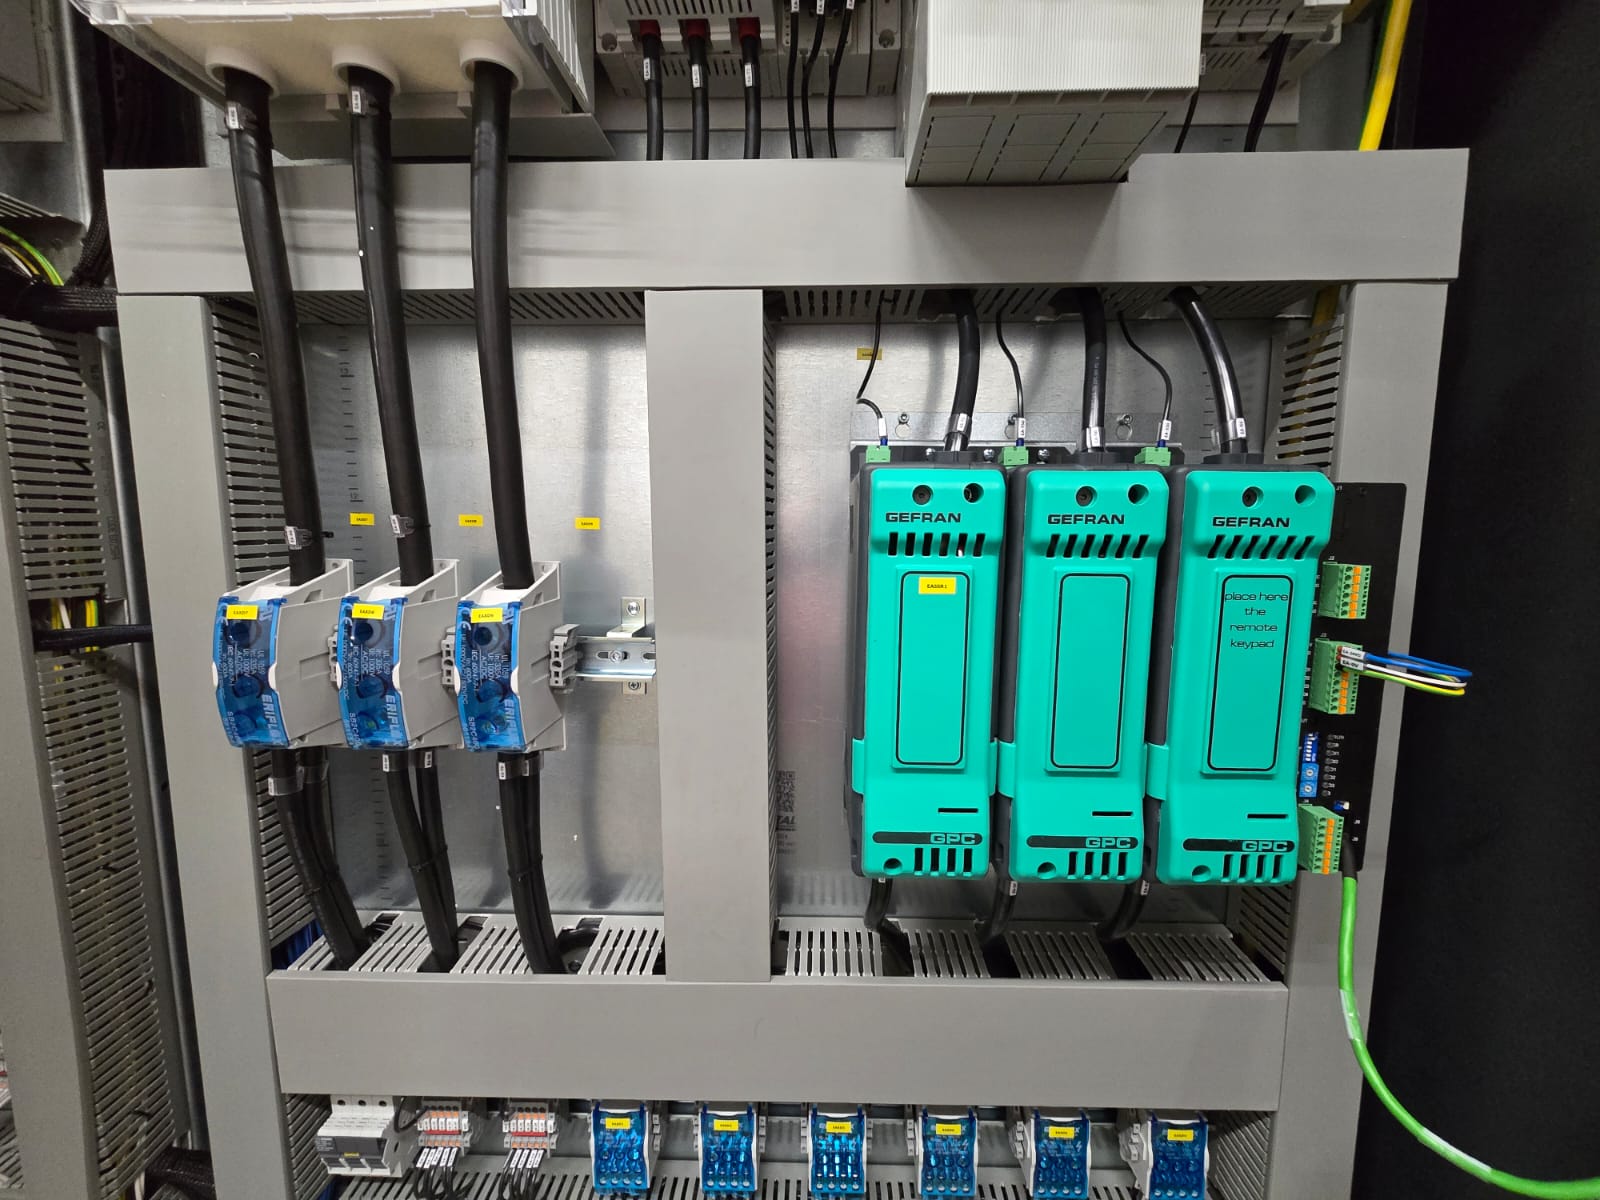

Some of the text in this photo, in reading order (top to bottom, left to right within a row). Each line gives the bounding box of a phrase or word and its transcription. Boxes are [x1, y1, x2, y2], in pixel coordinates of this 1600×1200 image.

[885, 512, 961, 523] GEFRAN
[1047, 514, 1125, 525] GEFRAN
[1212, 516, 1290, 527] GEFRAN
[1224, 592, 1289, 603] place here
[1244, 607, 1266, 616] the
[1230, 624, 1278, 632] remote
[1230, 640, 1275, 650] keypad
[930, 833, 976, 845] GPC
[1085, 837, 1131, 849] GPC
[1241, 840, 1288, 852] GPC
